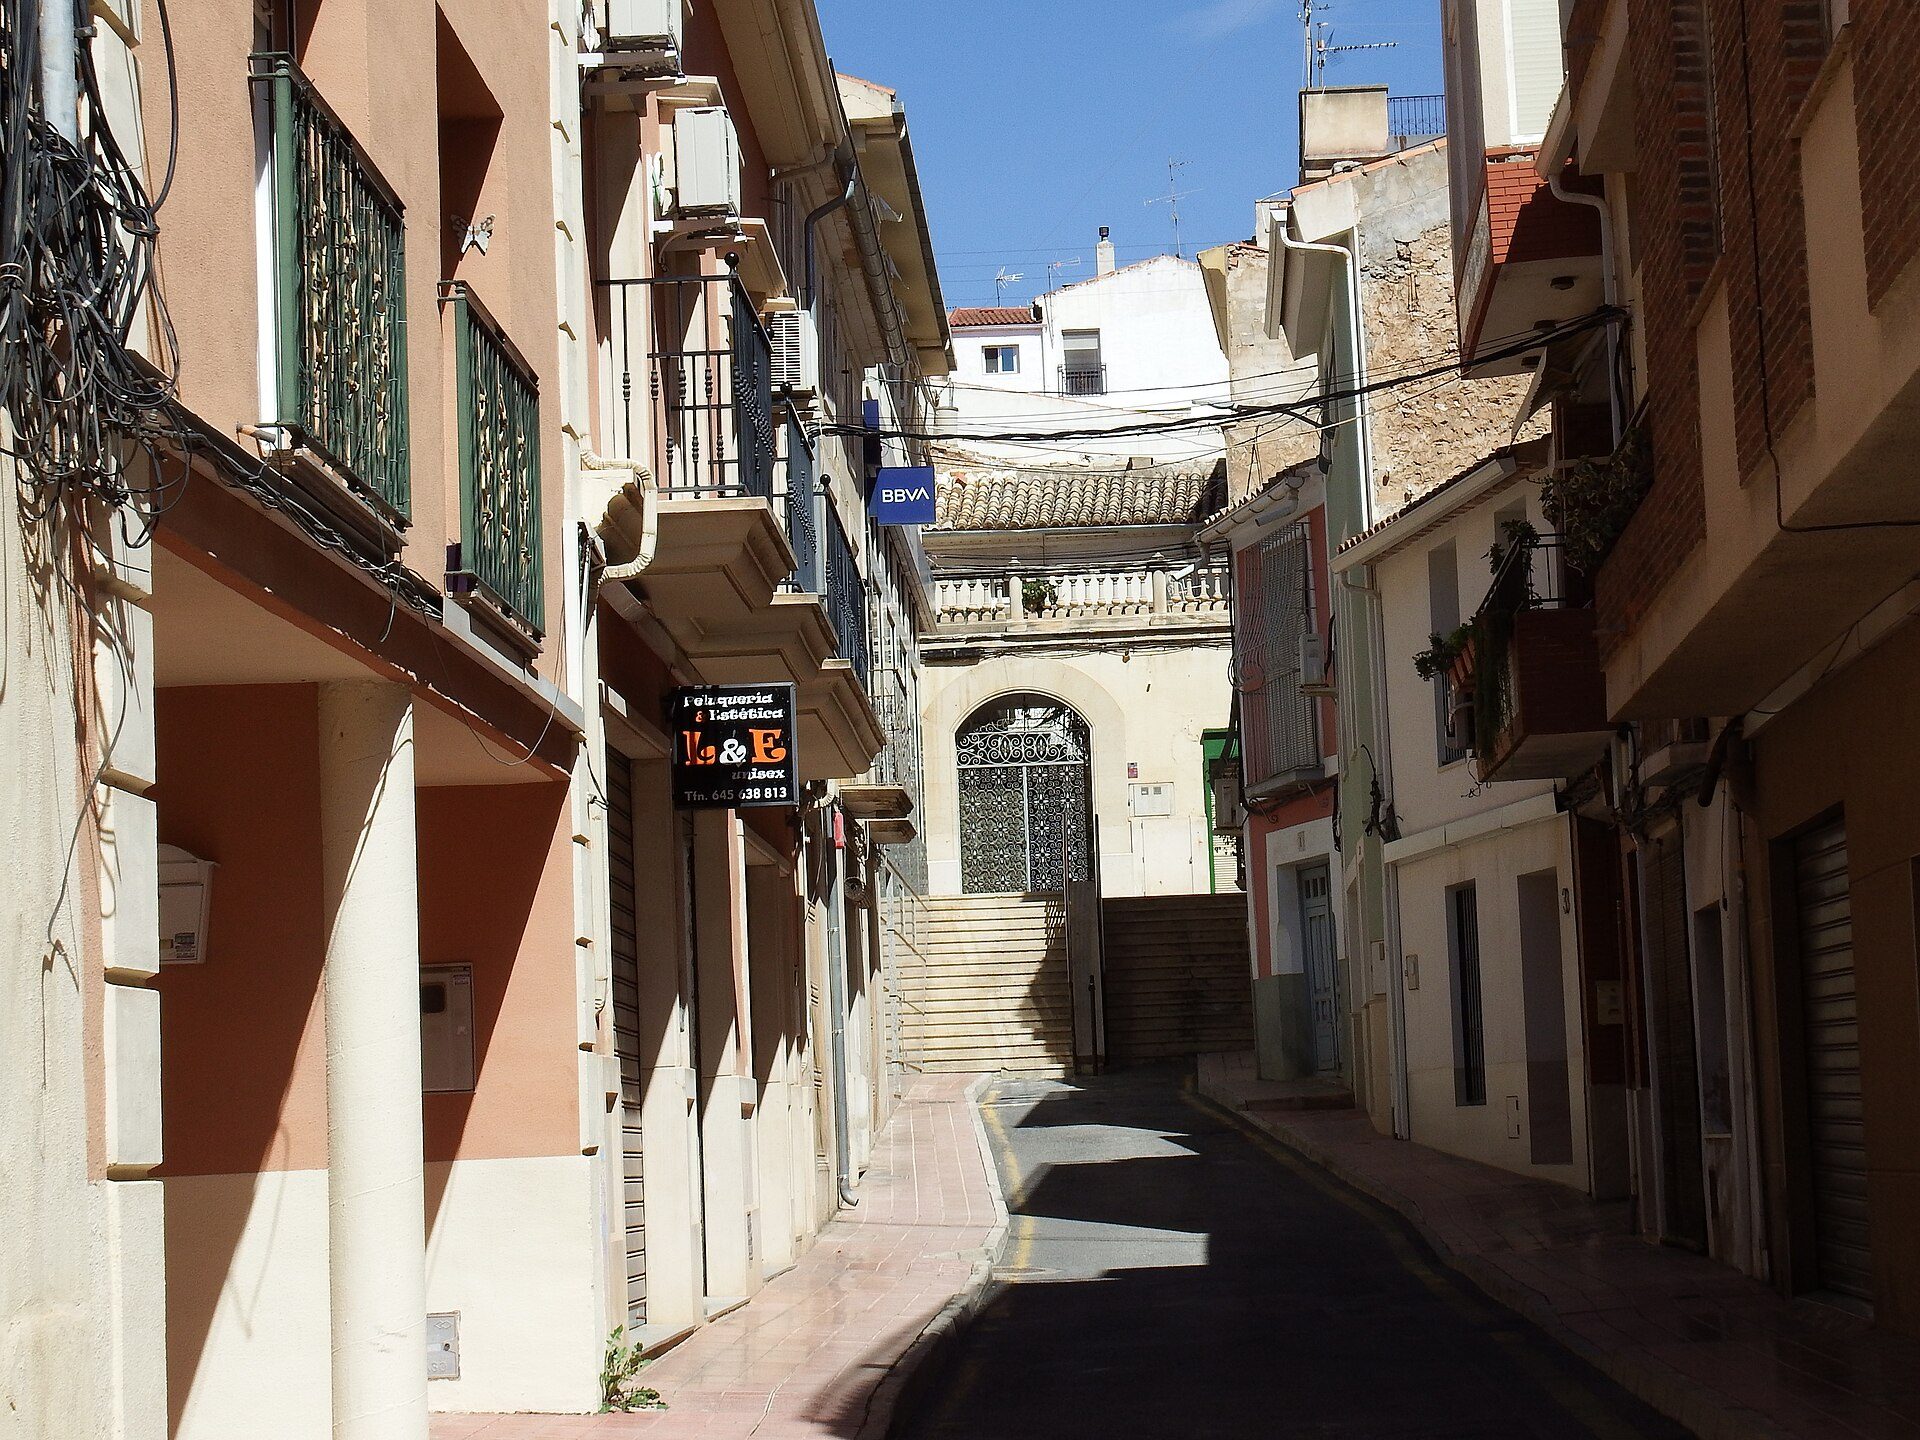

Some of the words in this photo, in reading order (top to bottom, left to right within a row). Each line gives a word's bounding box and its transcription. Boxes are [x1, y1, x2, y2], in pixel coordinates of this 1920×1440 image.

[882, 487, 929, 503] BBVA
[709, 707, 783, 720] Estética
[719, 738, 747, 764] &
[749, 729, 786, 763] E
[732, 768, 785, 780] unisex
[685, 790, 708, 801] Tfn.
[712, 789, 734, 800] 645
[739, 788, 761, 799] 638
[764, 787, 787, 799] 813
